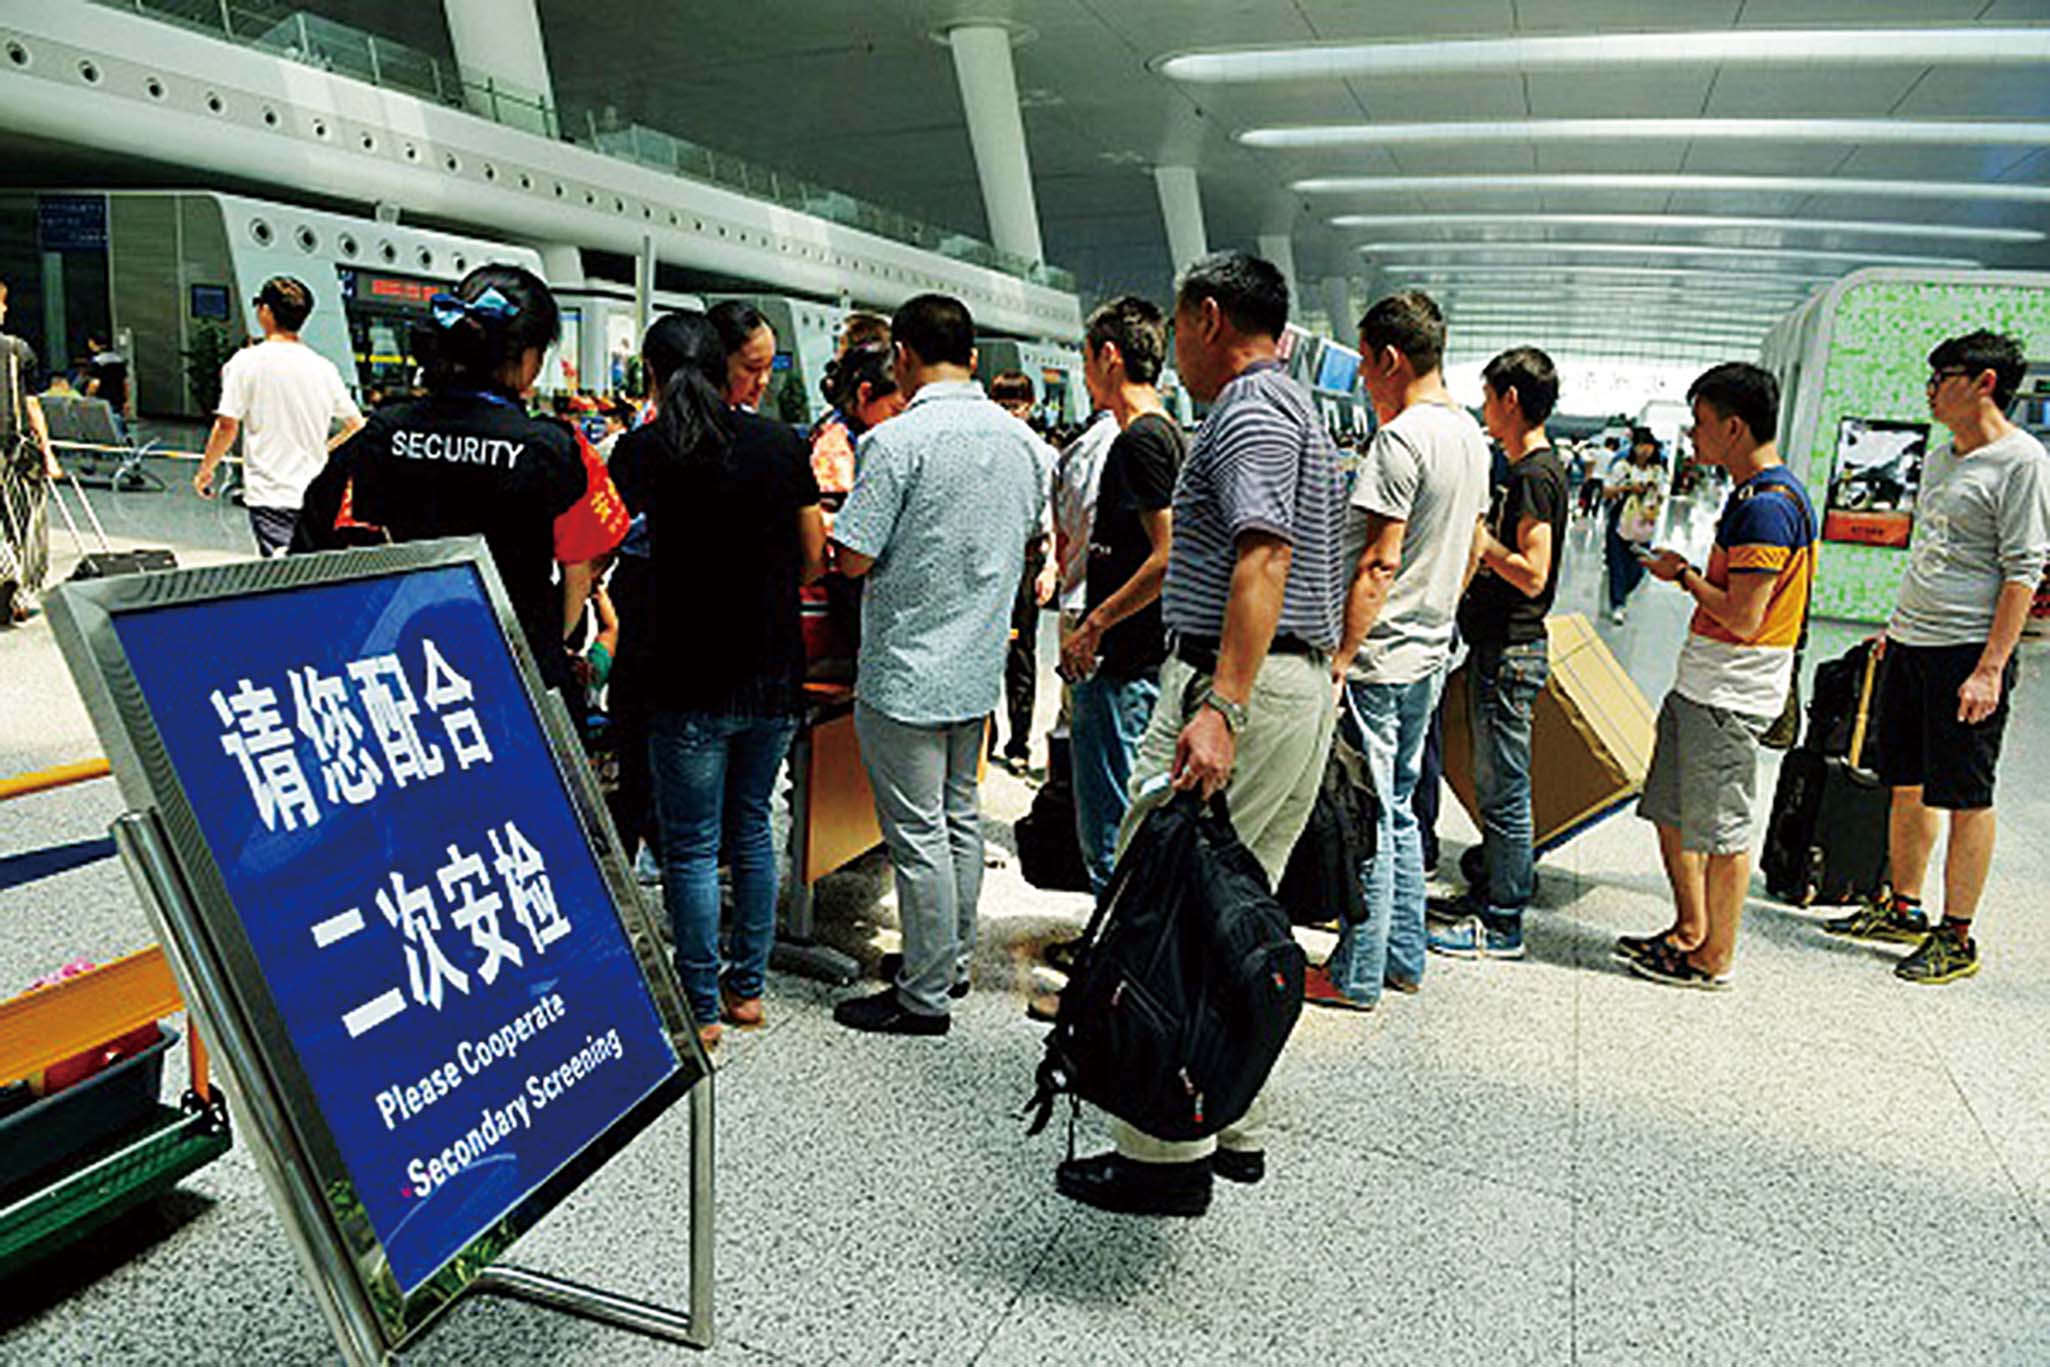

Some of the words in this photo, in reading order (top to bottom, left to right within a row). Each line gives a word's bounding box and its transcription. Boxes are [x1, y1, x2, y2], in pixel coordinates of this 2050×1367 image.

[391, 429, 525, 469] SECURITY
[210, 638, 494, 832] 请您配合
[310, 820, 572, 1038] 二次安检
[375, 1061, 462, 1131] Please
[457, 993, 566, 1058] Cooperate
[407, 1095, 531, 1198] Secondary
[525, 1028, 623, 1109] Screening
